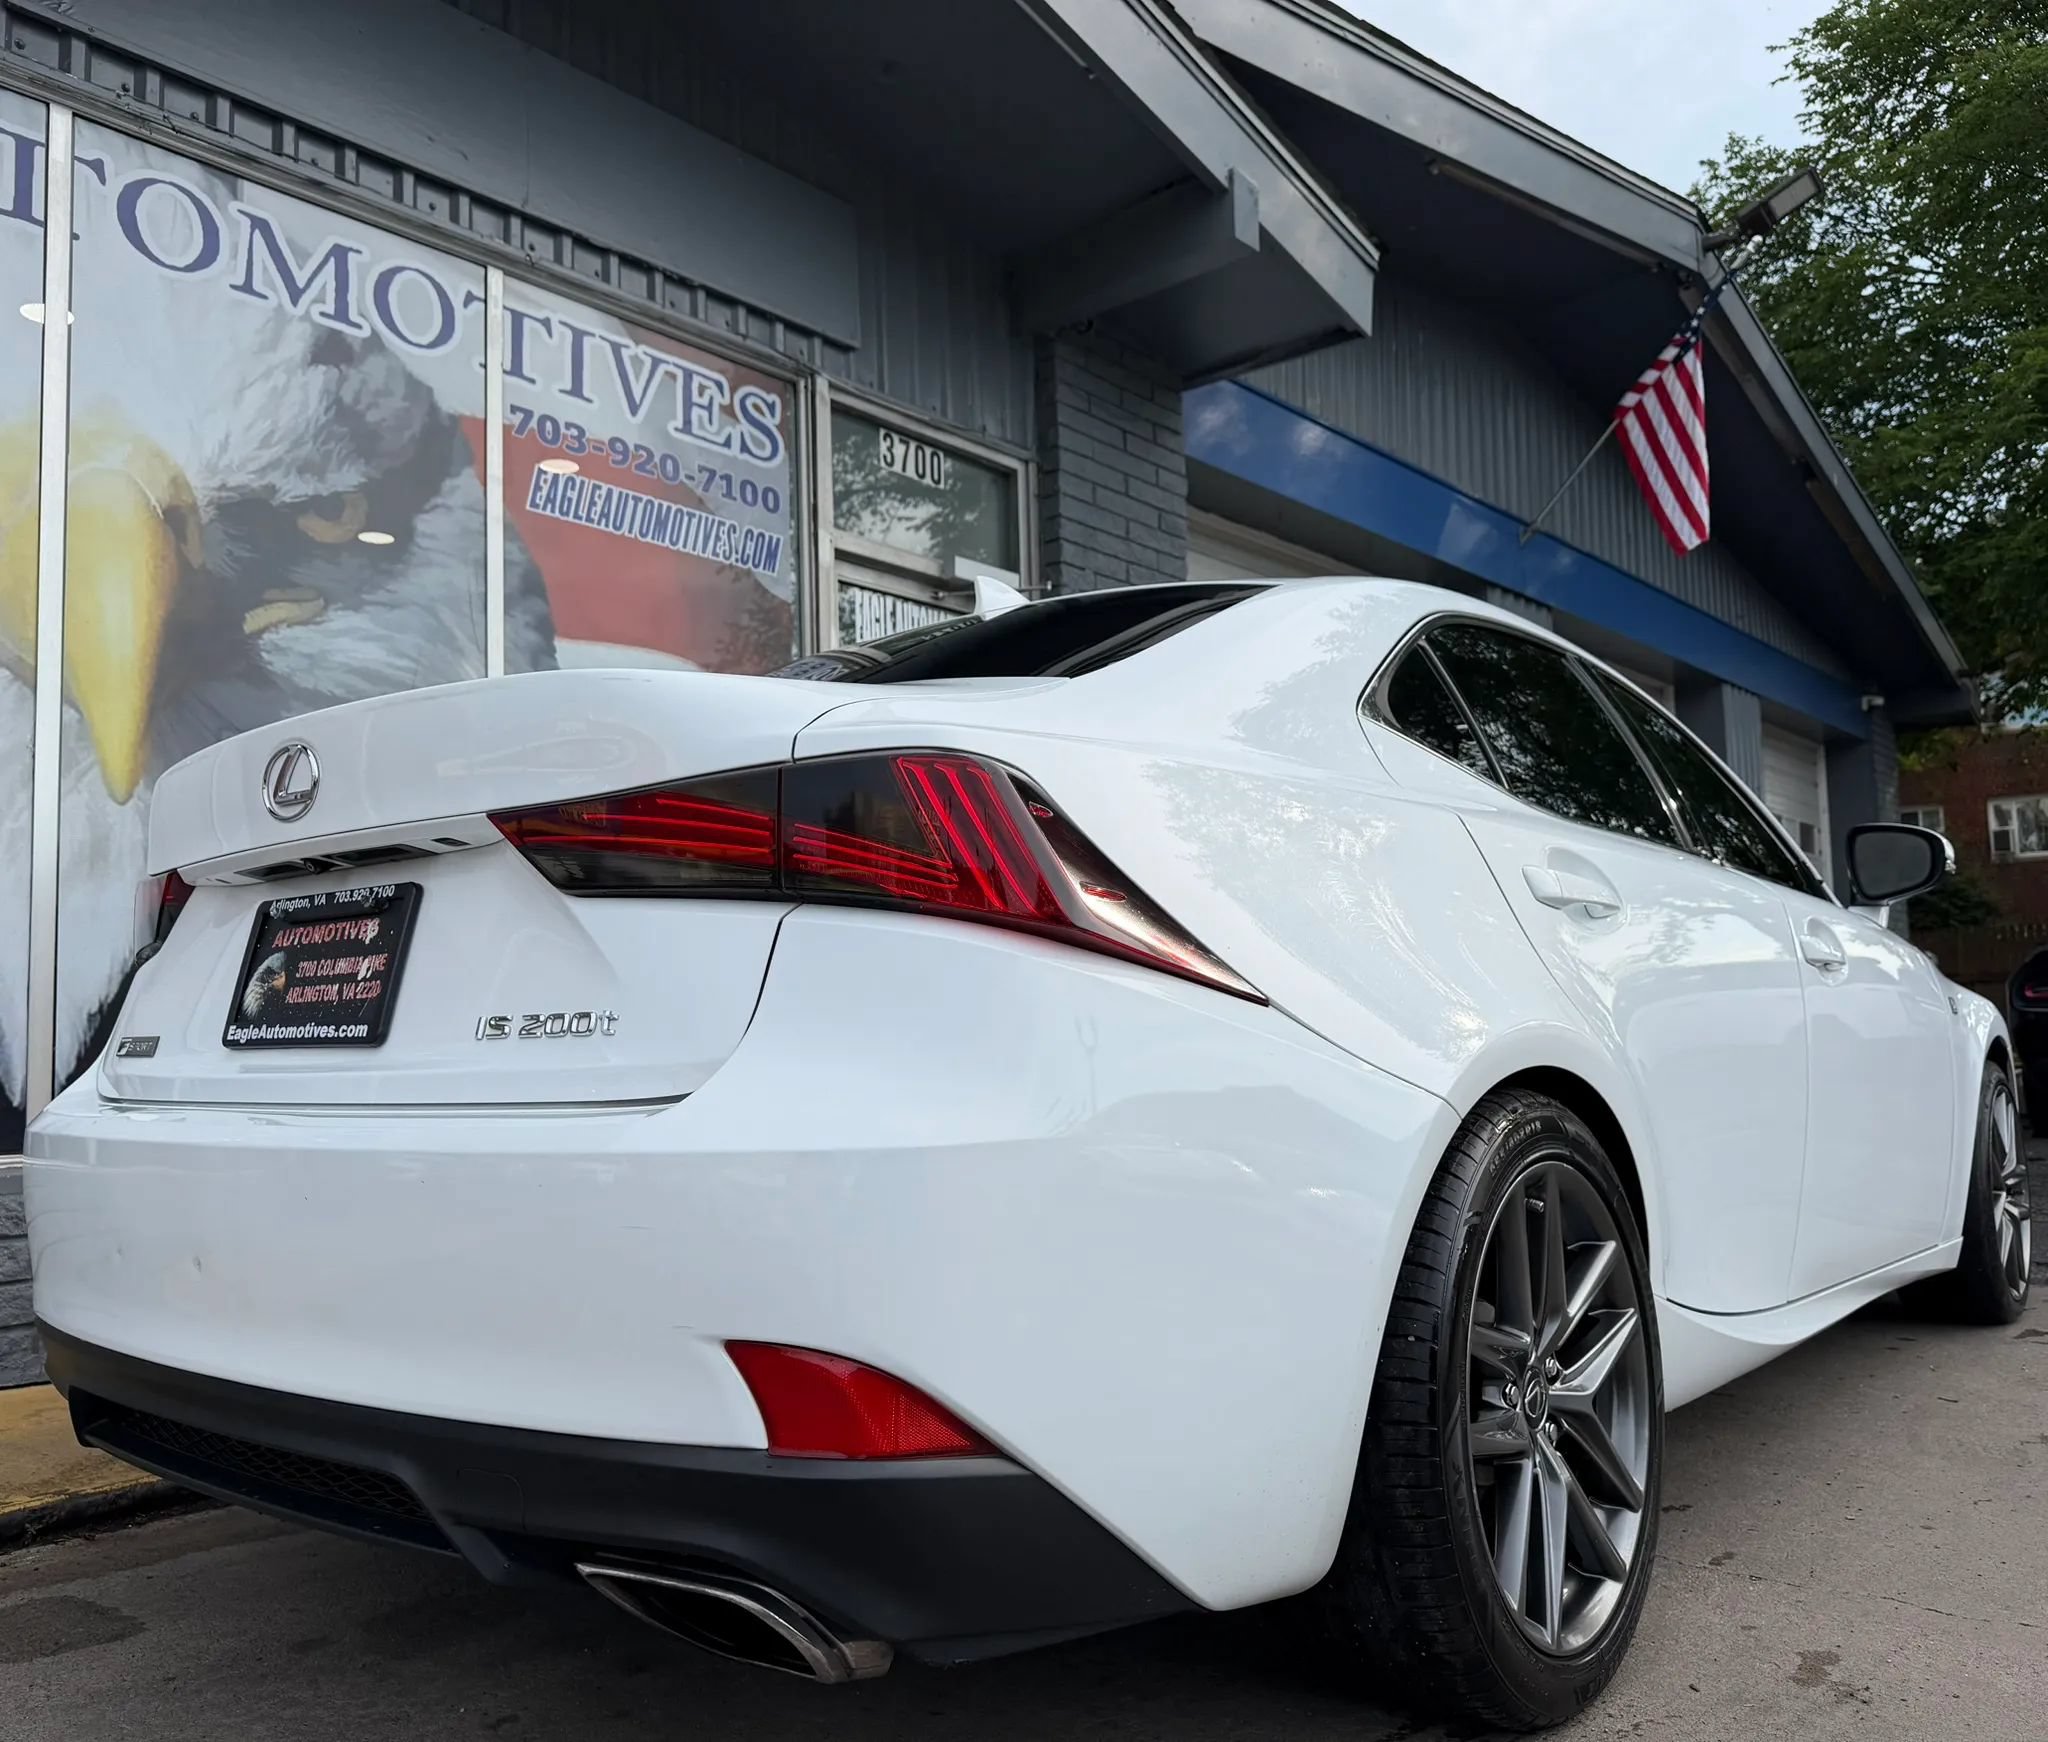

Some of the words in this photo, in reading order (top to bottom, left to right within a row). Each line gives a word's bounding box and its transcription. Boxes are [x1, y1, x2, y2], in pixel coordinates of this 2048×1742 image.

[509, 404, 781, 514] 703-920-7100
[883, 432, 942, 486] 3700
[528, 467, 783, 574] EAGLEAUTOMOTIVES.COM
[314, 894, 326, 905] VA
[286, 984, 339, 1004] ARLINGTON,
[343, 982, 356, 1000] VA
[227, 1022, 369, 1044] EagleAutomotives.com
[475, 1014, 513, 1040] IS
[518, 1010, 620, 1039] 200t
